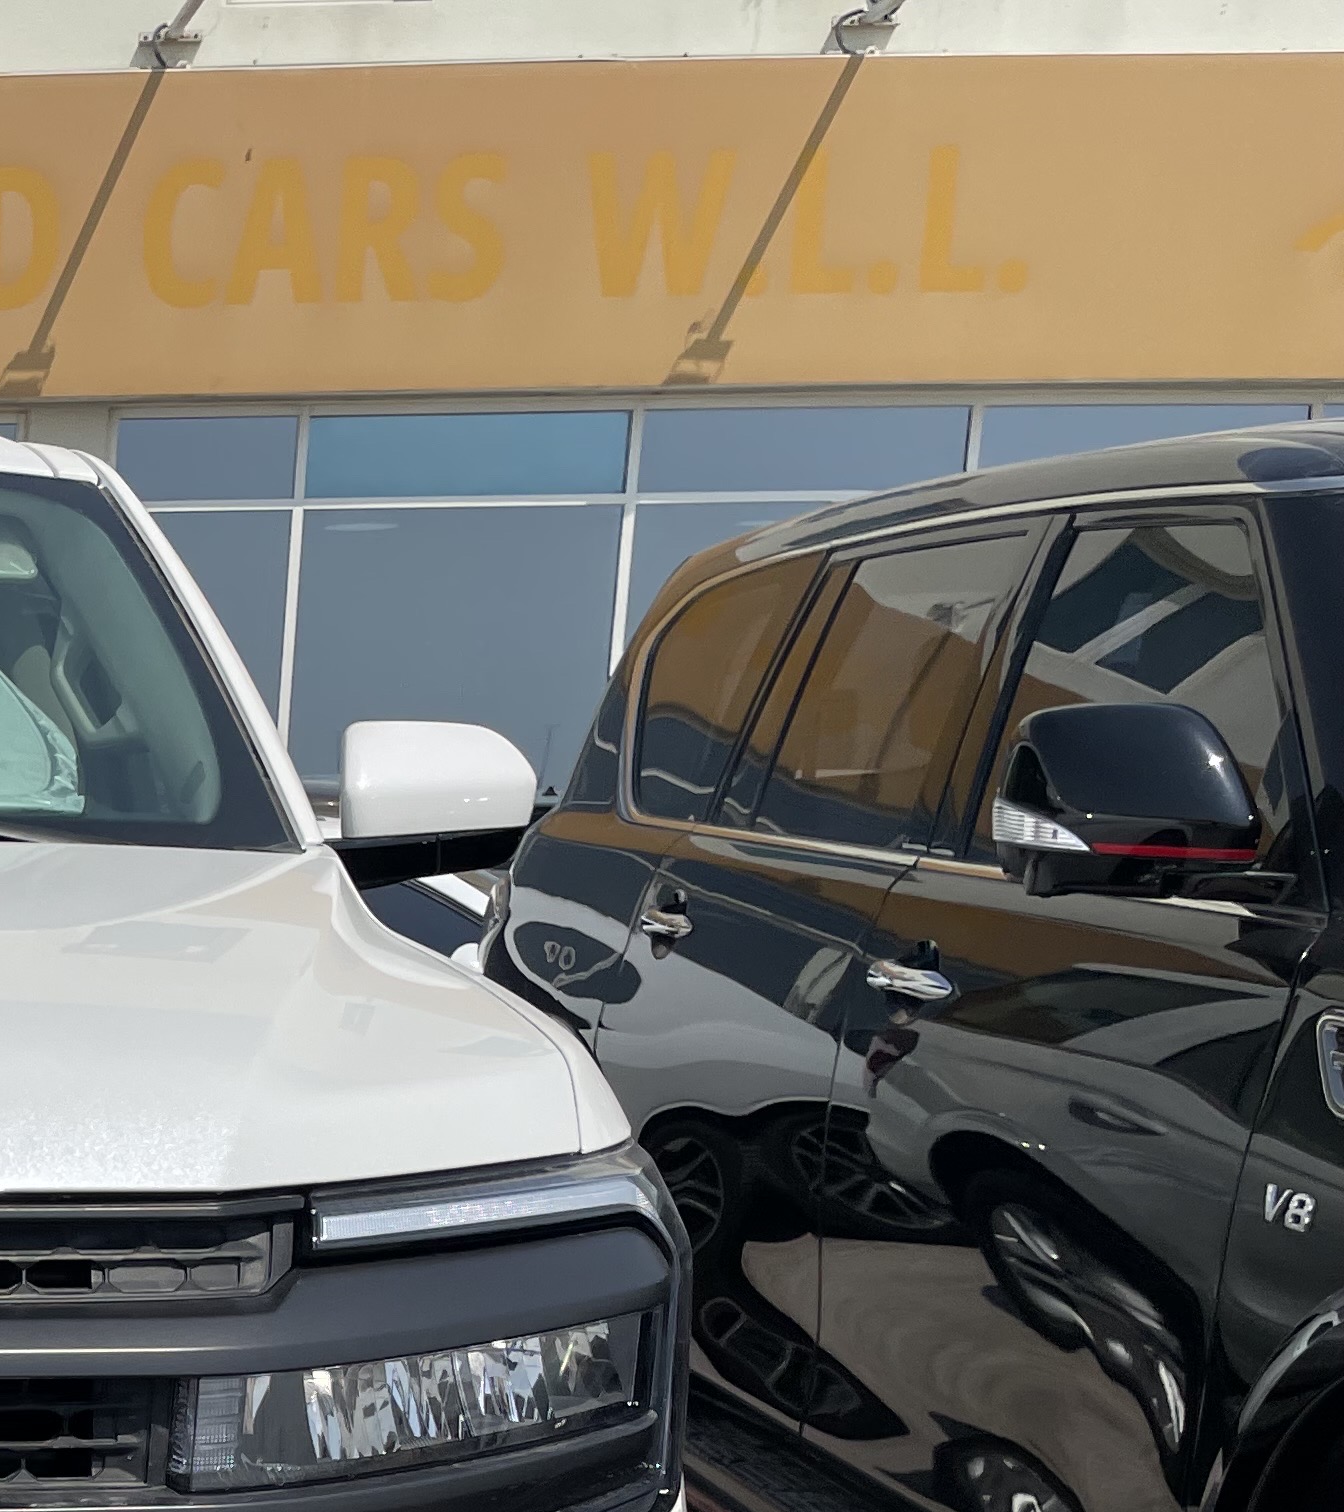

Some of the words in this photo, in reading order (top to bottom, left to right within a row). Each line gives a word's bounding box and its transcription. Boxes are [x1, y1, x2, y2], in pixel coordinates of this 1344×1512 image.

[140, 150, 509, 309] CARS
[587, 144, 1030, 298] W.L.L.
[1264, 1183, 1315, 1232] V8
